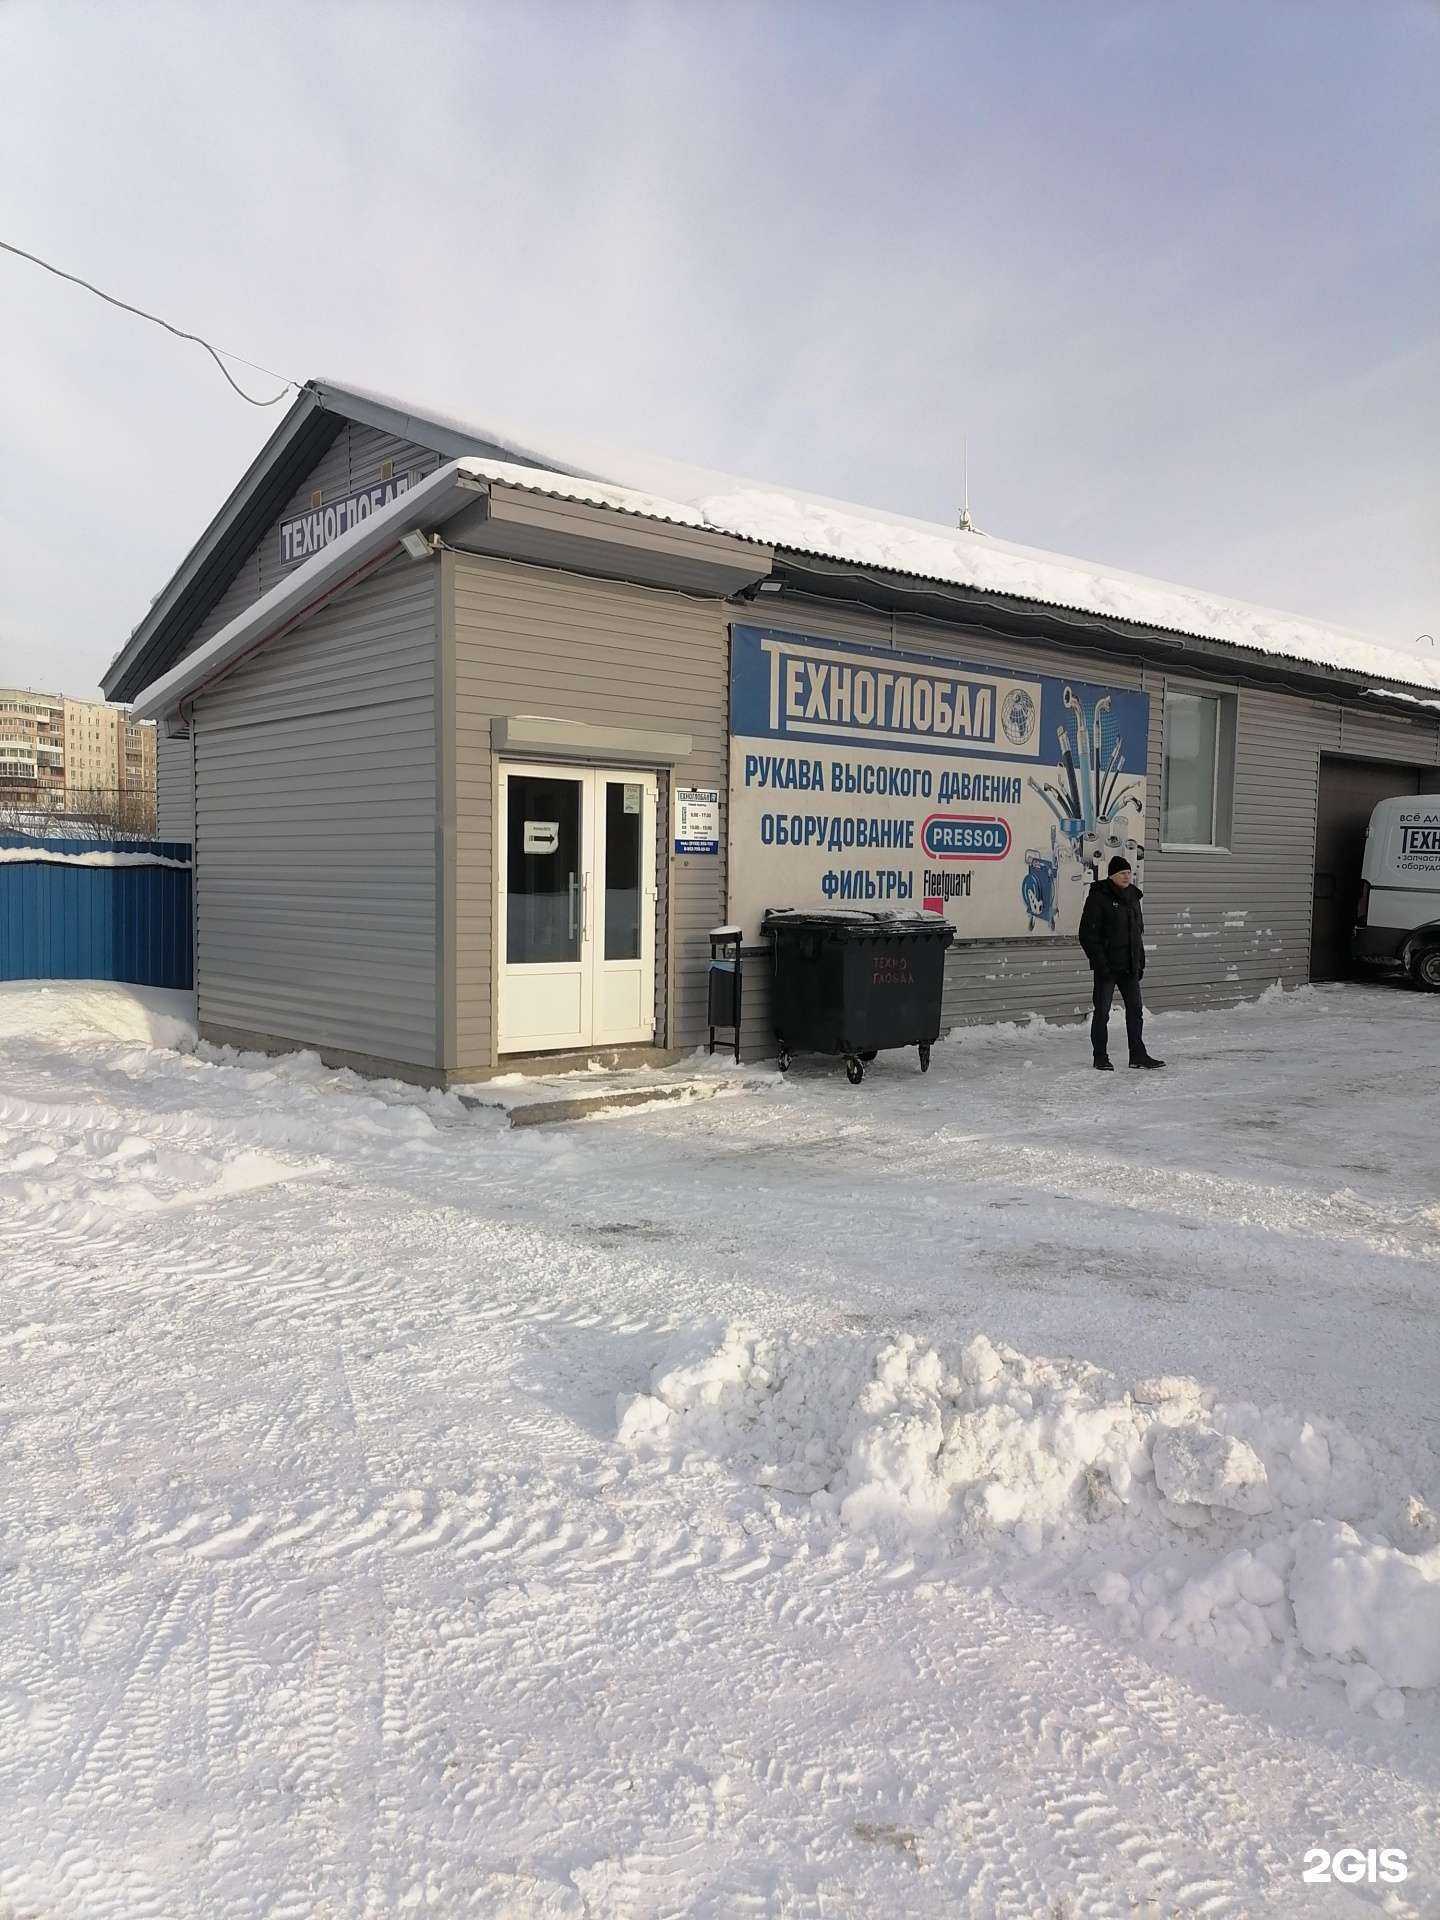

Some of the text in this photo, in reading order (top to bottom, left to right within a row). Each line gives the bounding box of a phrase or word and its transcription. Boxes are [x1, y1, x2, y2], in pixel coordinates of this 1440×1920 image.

[760, 638, 994, 739] ТЕХНОГЛОБАЛ
[745, 755, 1022, 804] РУКАВА ВЫСОКОГО ДАВЛЕНИЯ
[761, 814, 914, 852] ОБОРУДОВАНИЕ
[1400, 813, 1421, 822] всё
[933, 828, 1003, 848] PRESSOL
[821, 870, 913, 900] ФИЛЬТРЫ
